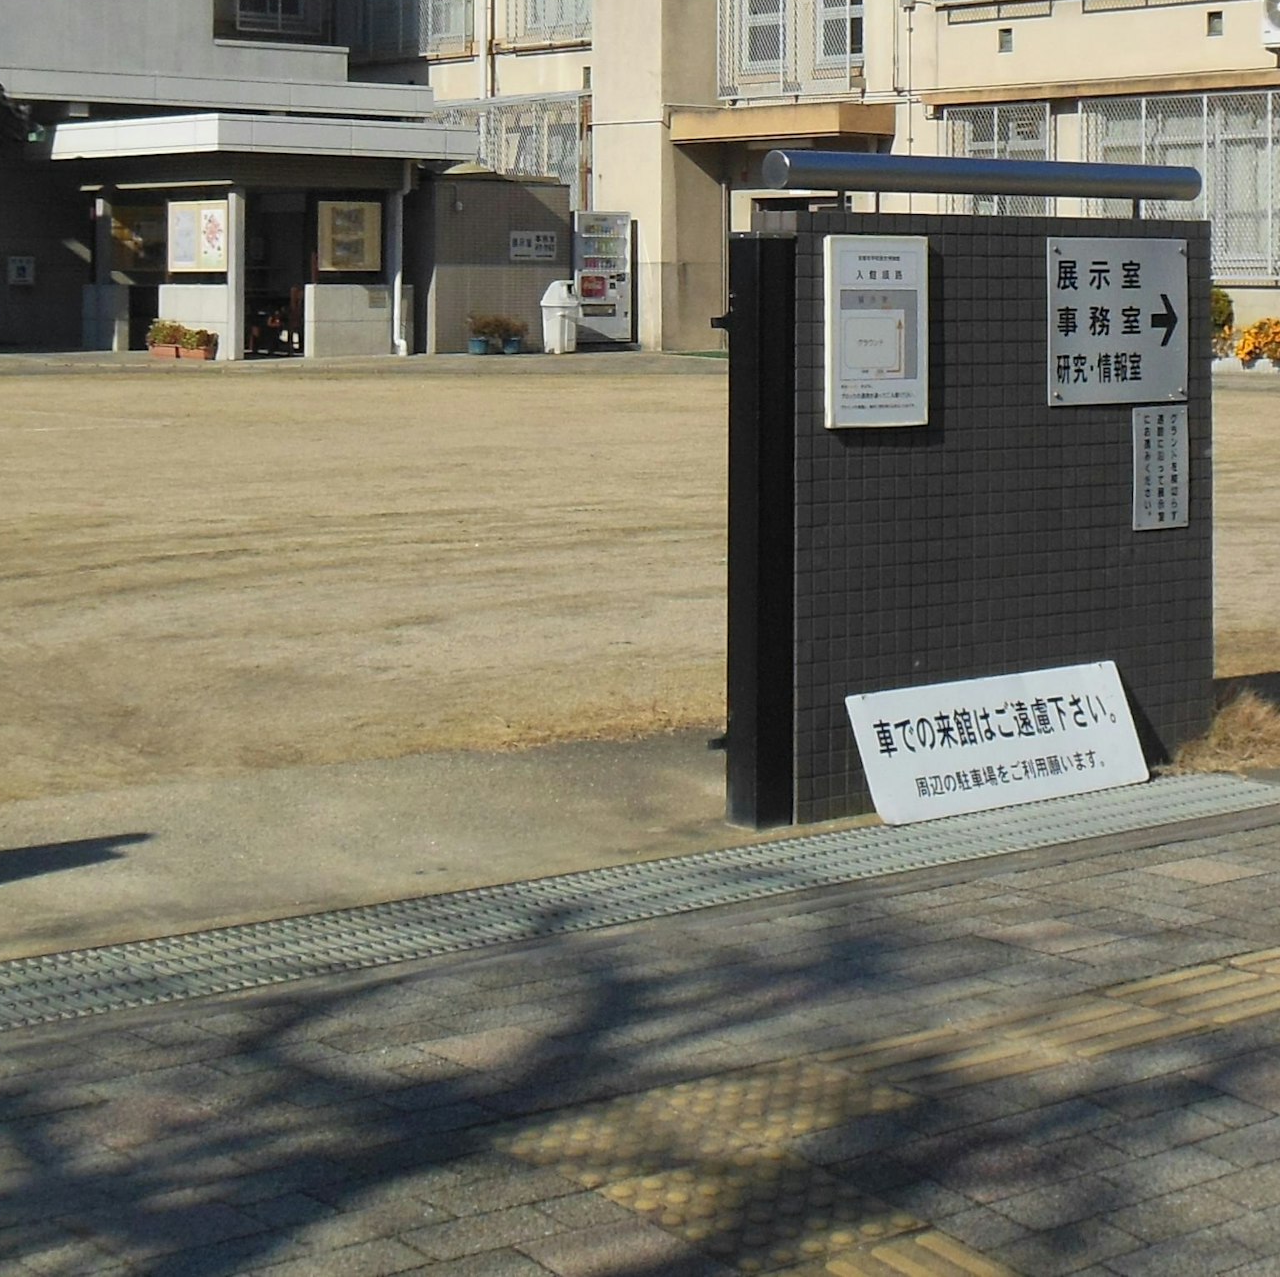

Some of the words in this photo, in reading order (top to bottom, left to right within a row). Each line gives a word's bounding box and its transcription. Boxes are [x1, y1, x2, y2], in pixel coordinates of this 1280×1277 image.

[1056, 260, 1142, 291] 展示室
[1056, 306, 1142, 337] 事務室
[1056, 352, 1142, 384] 研究・情報室
[873, 693, 1118, 758] 車での来館はご遠慮下さい。
[915, 748, 1106, 798] 周辺の駐車場をご利用願います。
